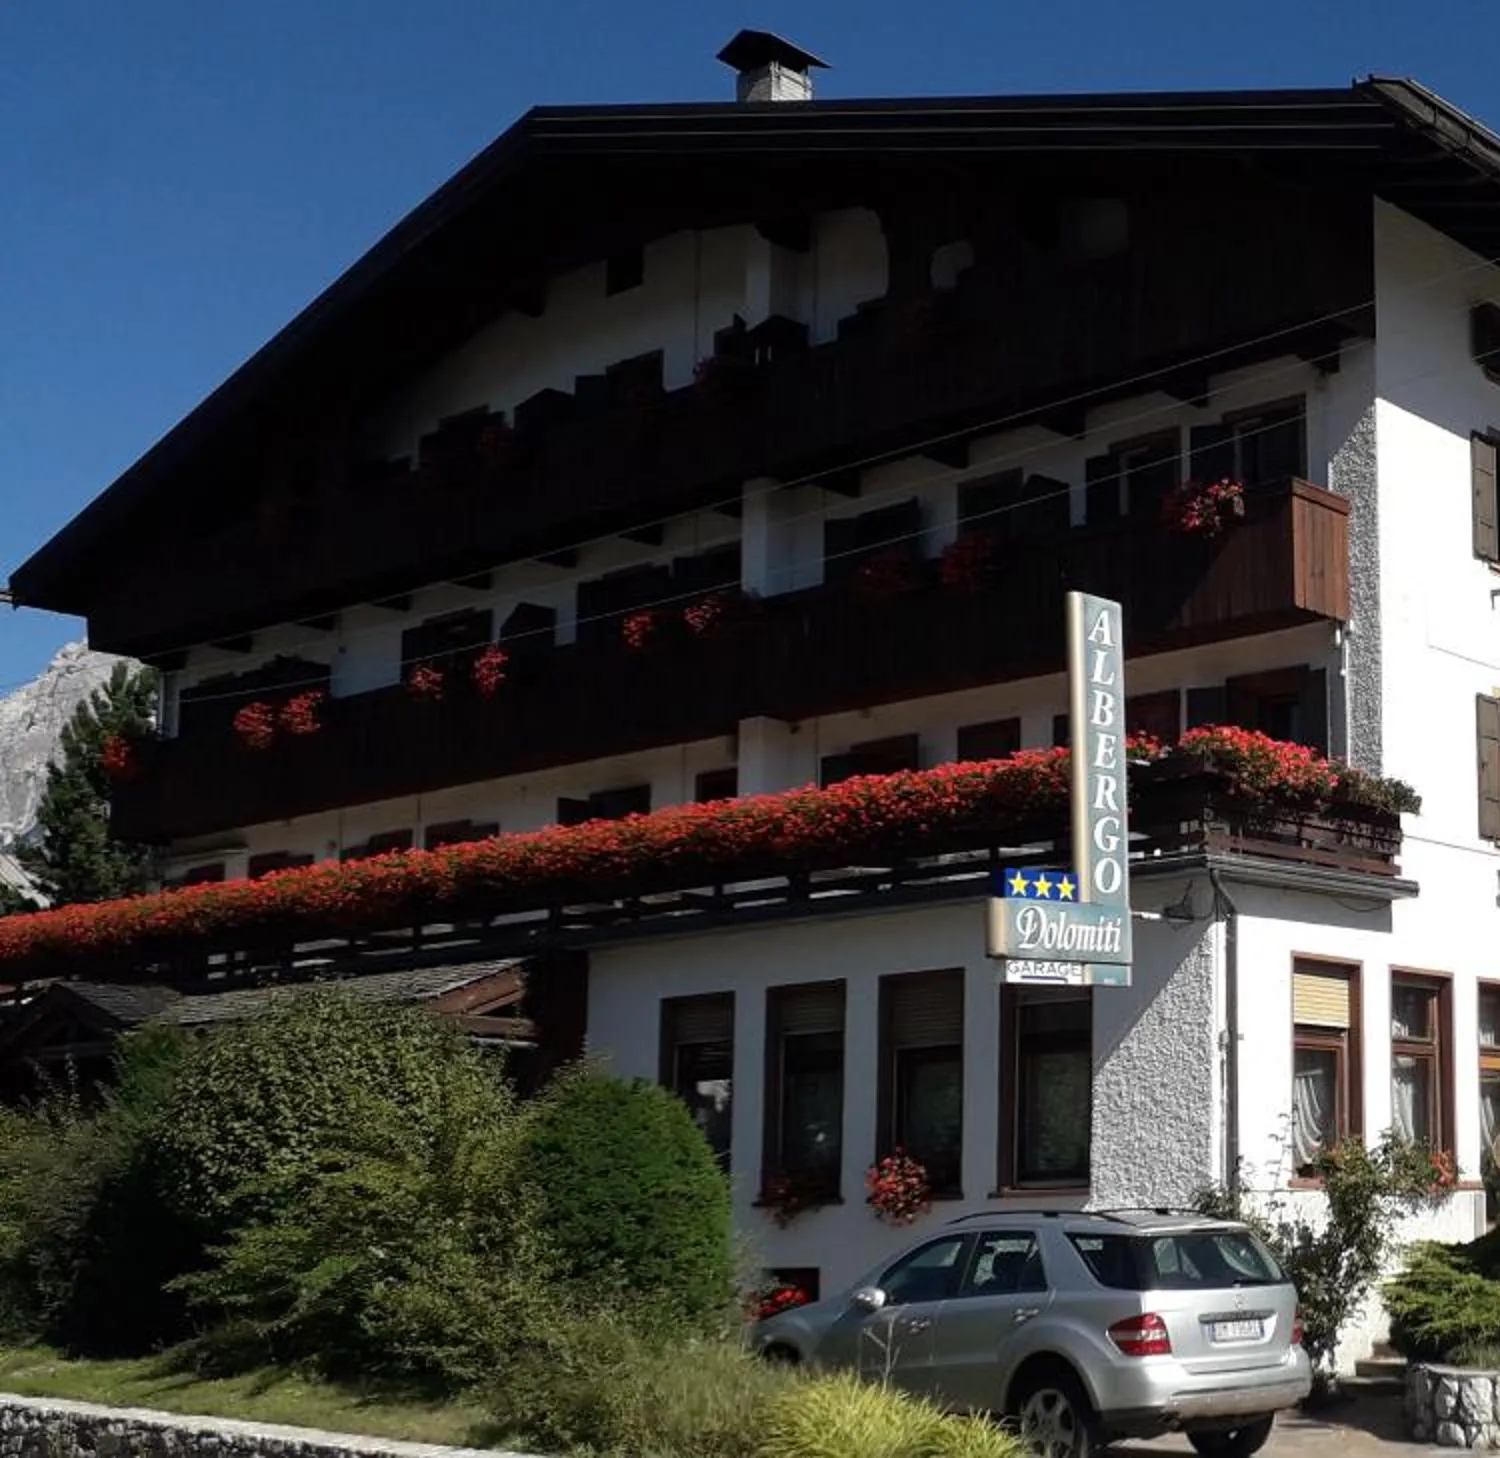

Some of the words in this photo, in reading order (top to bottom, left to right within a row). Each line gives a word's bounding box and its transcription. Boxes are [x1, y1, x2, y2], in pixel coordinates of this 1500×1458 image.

[1087, 609, 1122, 895] ALBERGO
[1016, 906, 1122, 954] Dolomiti
[1007, 959, 1083, 976] GARAGE
